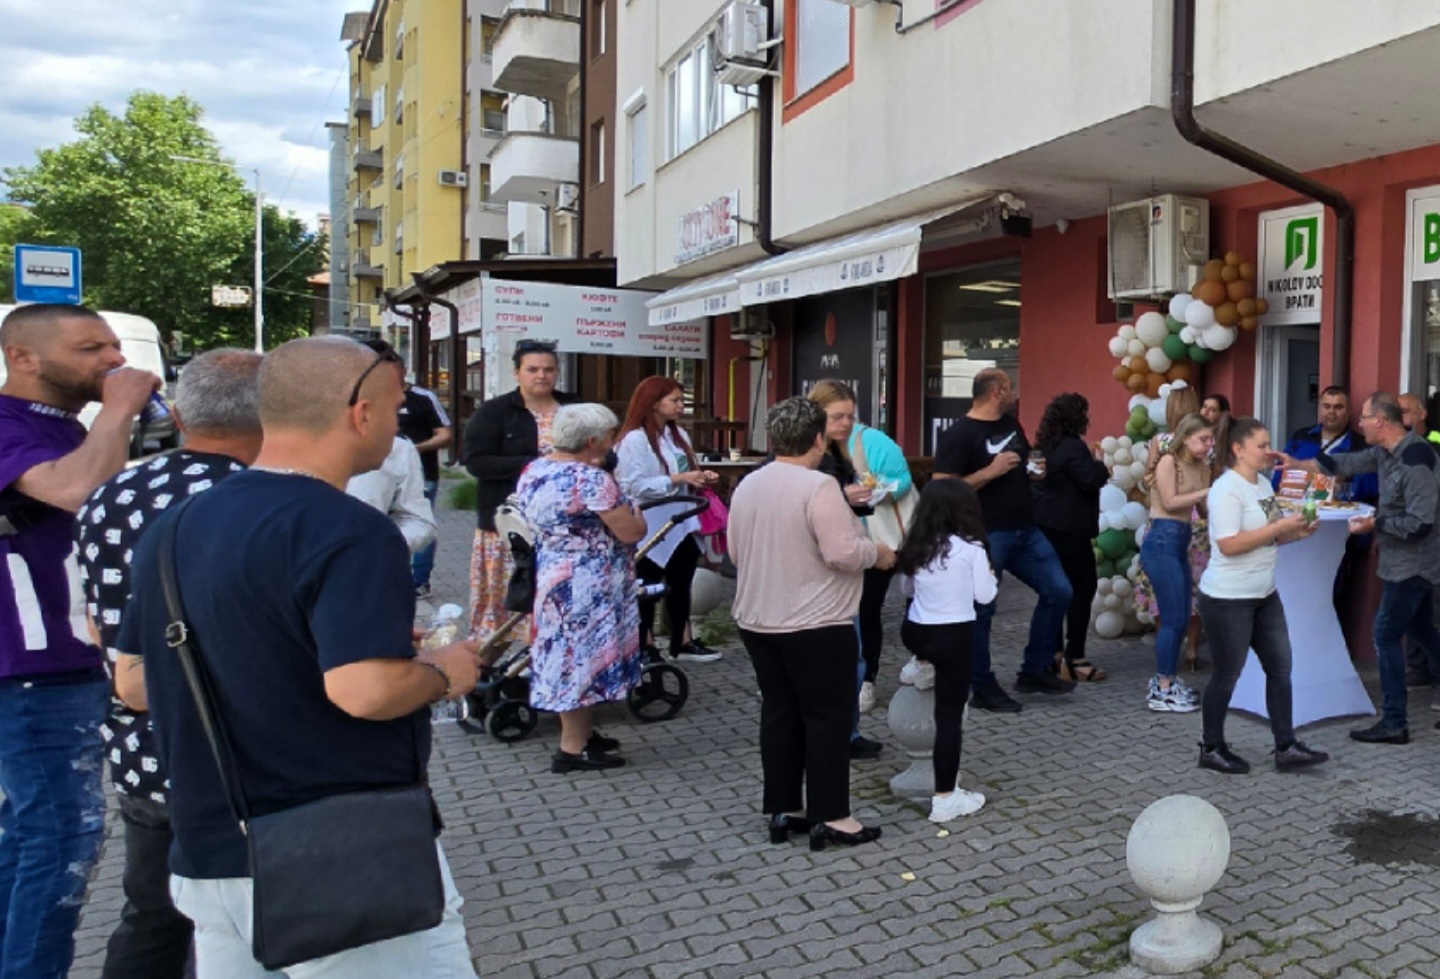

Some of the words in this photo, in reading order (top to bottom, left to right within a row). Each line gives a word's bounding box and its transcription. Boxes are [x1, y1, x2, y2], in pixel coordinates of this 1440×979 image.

[1267, 277, 1304, 293] NIKOLOV
[1306, 275, 1323, 290] DOO
[582, 294, 618, 303] КЮФТЕ
[1286, 294, 1315, 309] ВРАТИ
[577, 318, 626, 328] ПЪРЖЕНИ
[577, 328, 625, 338] КАРТОФИ
